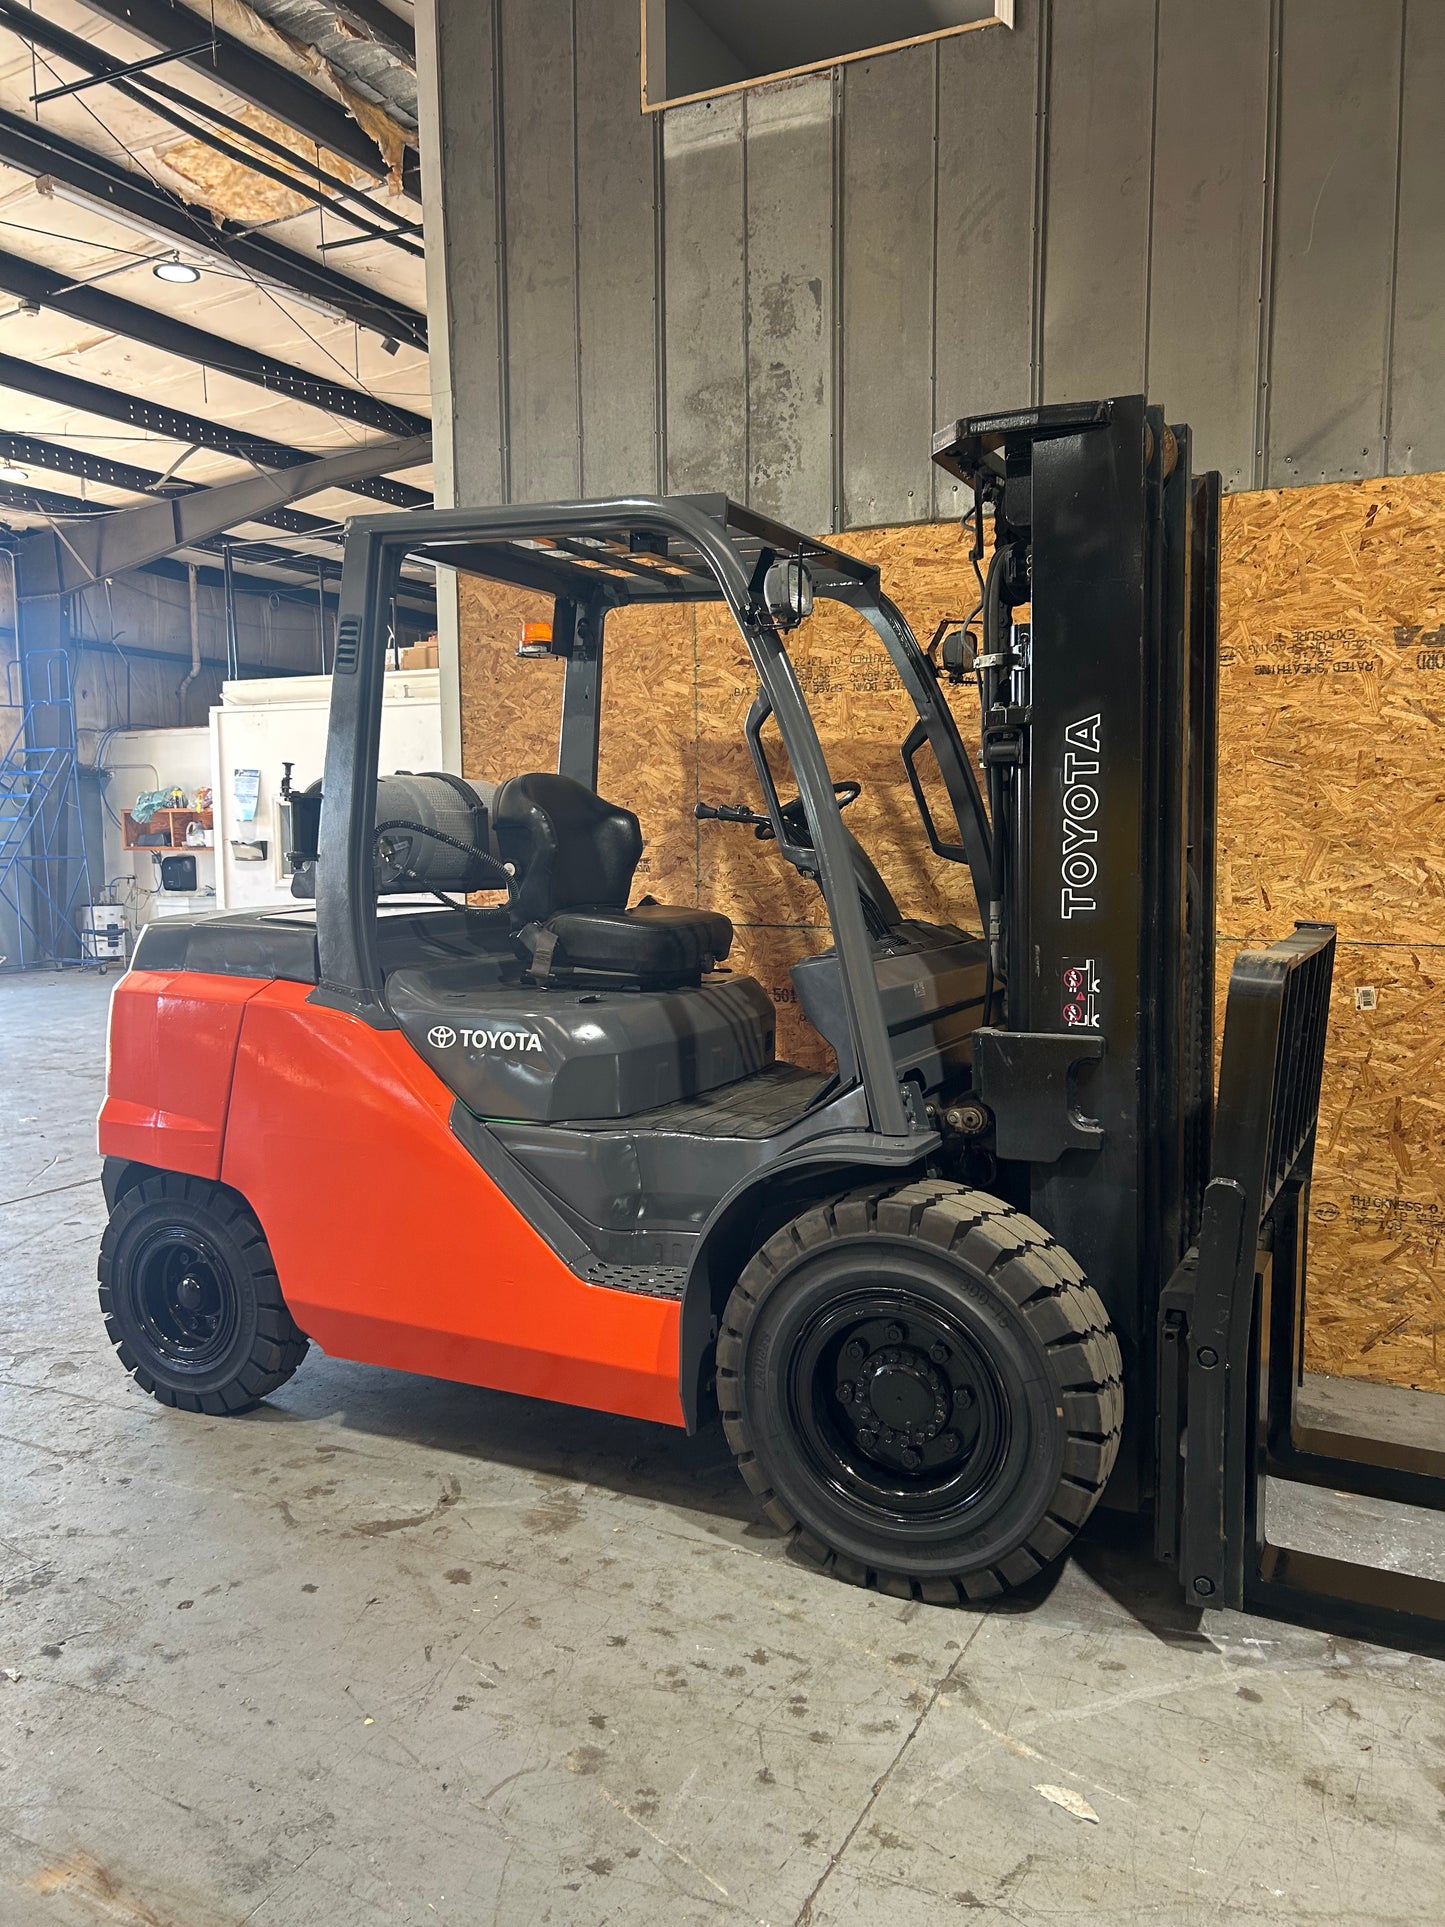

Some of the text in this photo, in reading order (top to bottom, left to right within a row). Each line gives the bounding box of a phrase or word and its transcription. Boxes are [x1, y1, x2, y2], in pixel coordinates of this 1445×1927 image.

[1292, 629, 1356, 641] EXPOSURE
[1254, 661, 1374, 675] RATED SHEATHING
[1061, 713, 1101, 919] TOYOTA
[460, 1029, 543, 1052] TOYOTA
[1350, 1194, 1422, 1213] THICKNESS
